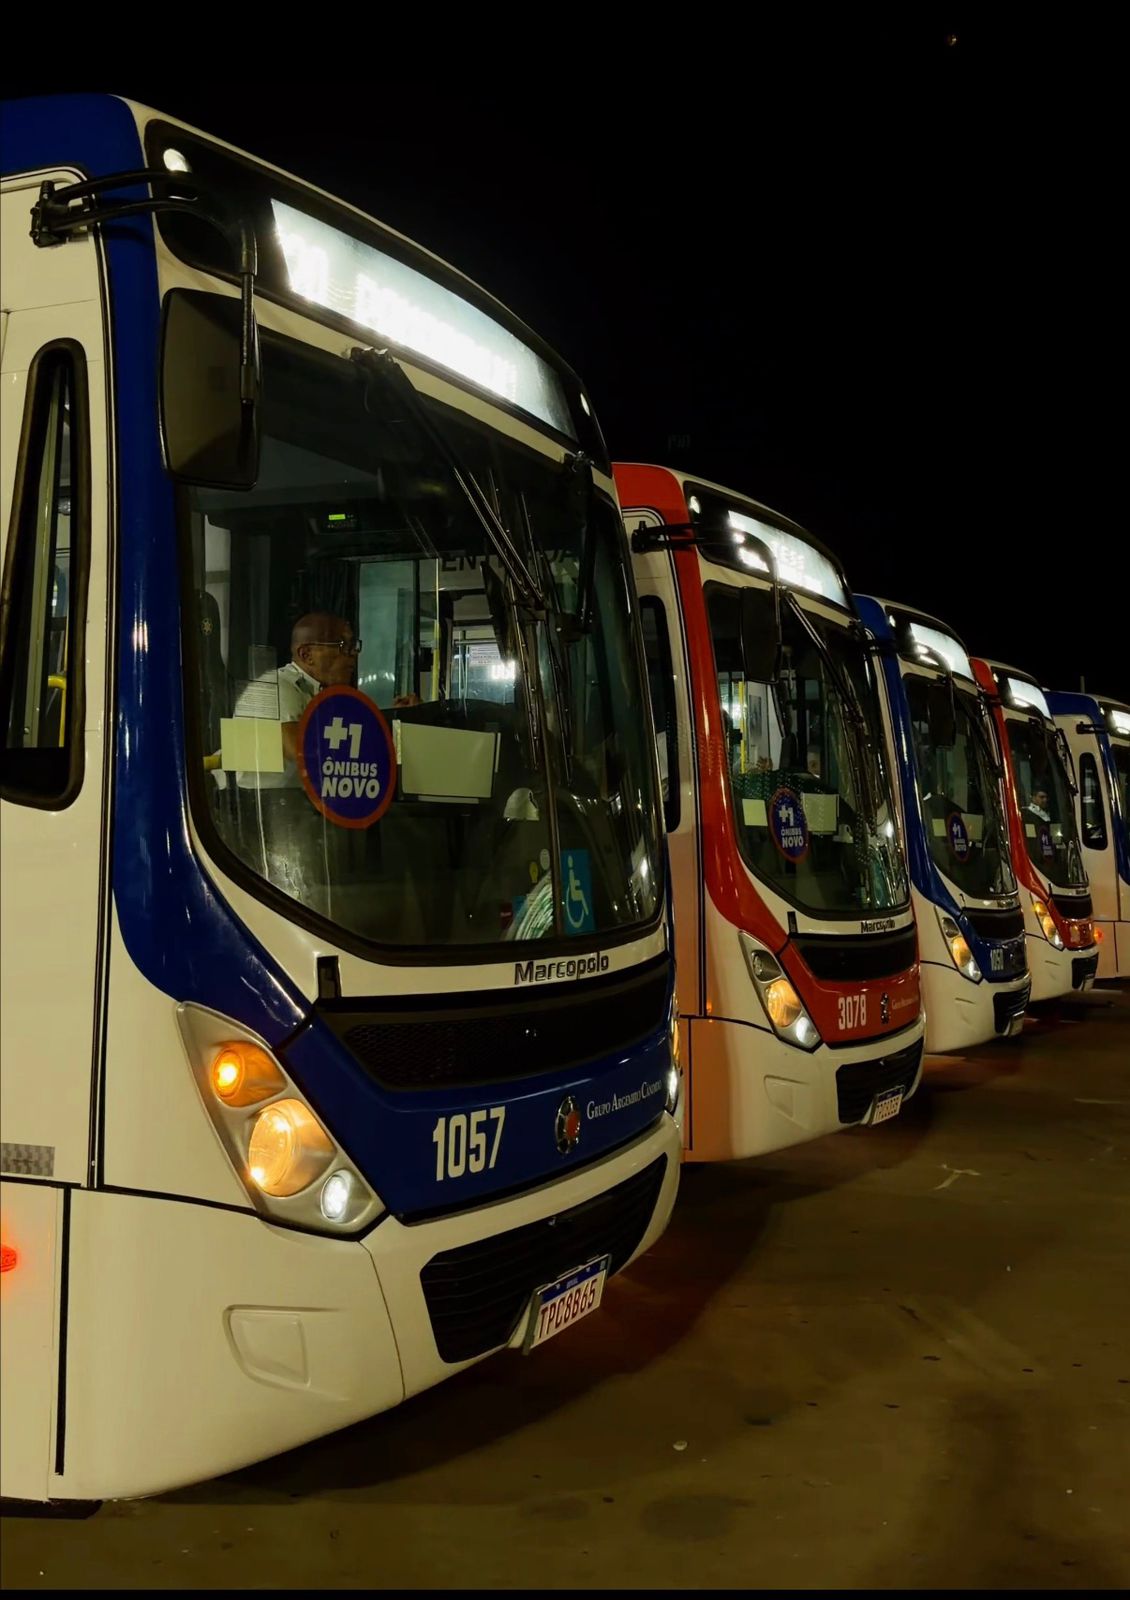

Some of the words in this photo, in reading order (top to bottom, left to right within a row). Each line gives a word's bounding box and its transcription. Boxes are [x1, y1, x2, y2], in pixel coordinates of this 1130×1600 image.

[323, 716, 363, 759] +1
[322, 756, 378, 778] ÔNIBUS
[321, 776, 380, 799] NOVO
[781, 835, 804, 848] NOVO
[515, 952, 609, 985] Marcopolo
[838, 993, 867, 1031] 3078
[432, 1105, 506, 1182] 1057
[538, 1278, 598, 1340] TPC8B65
